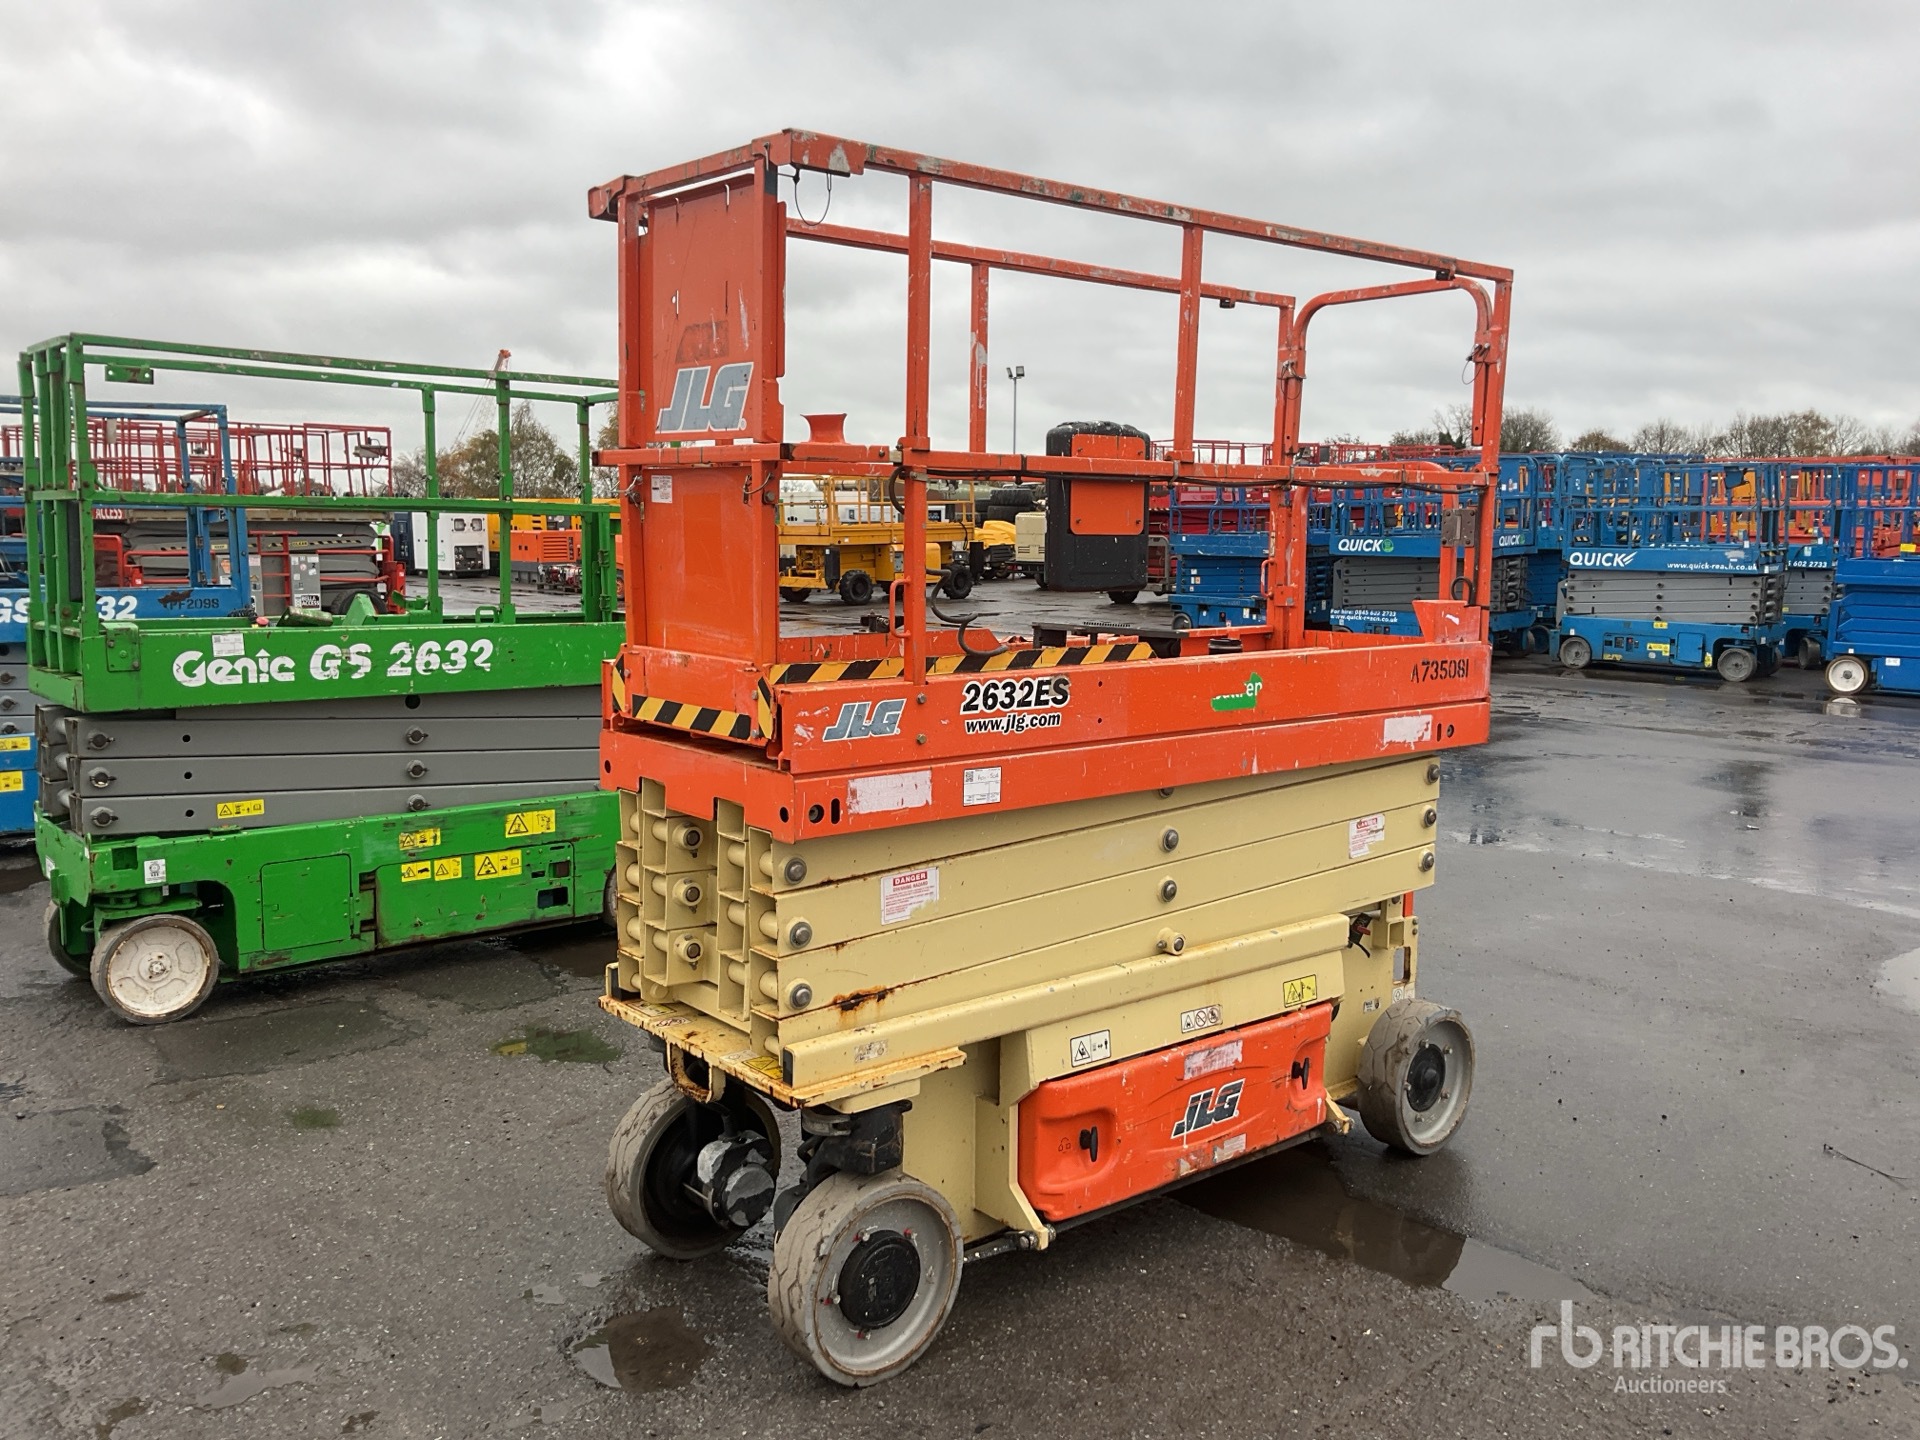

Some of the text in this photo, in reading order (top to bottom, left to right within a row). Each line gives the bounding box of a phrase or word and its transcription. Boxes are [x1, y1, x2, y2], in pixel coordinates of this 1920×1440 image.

[655, 361, 754, 434] JLG
[1338, 539, 1383, 552] QUICK
[1499, 534, 1520, 547] QUICK
[1569, 551, 1624, 568] QUICK
[96, 595, 138, 620] 32
[310, 643, 372, 680] GS
[387, 638, 494, 677] 2632
[1411, 658, 1469, 683] A735081
[961, 677, 1071, 714] 2632ES
[823, 698, 907, 742] JLG
[965, 713, 1061, 735] www.jlg.com
[894, 871, 927, 886] DANGER
[1171, 1078, 1246, 1139] JLG
